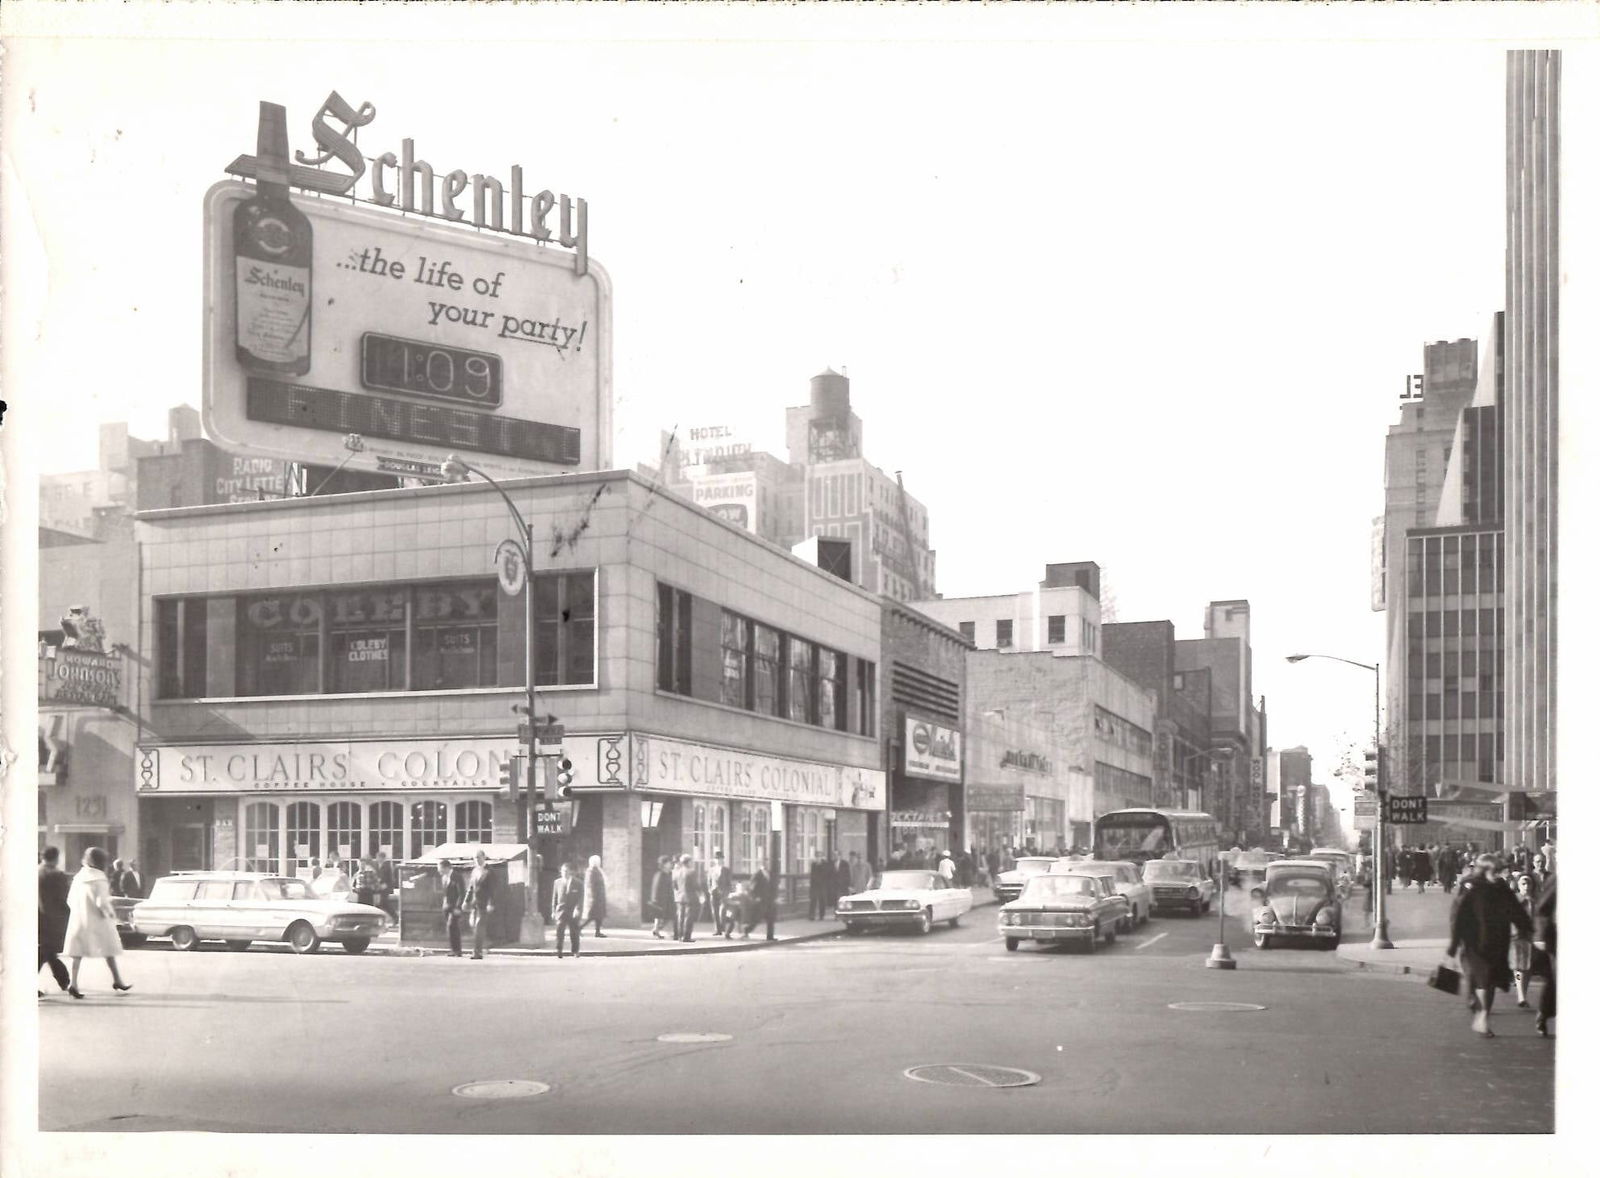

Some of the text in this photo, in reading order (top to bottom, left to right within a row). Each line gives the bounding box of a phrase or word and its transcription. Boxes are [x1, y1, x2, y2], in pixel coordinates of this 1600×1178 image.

[224, 90, 588, 277] Schenley
[244, 266, 305, 297] Schenley
[414, 257, 464, 291] life
[474, 271, 506, 299] of
[429, 301, 588, 352] your party!
[403, 346, 491, 398] 1:09
[690, 425, 732, 440] HOTEL
[695, 484, 753, 501] PARKING
[180, 756, 218, 783] ST.
[760, 765, 832, 797] COLONIAL
[537, 825, 563, 834] WALK
[1391, 811, 1425, 822] WALK
